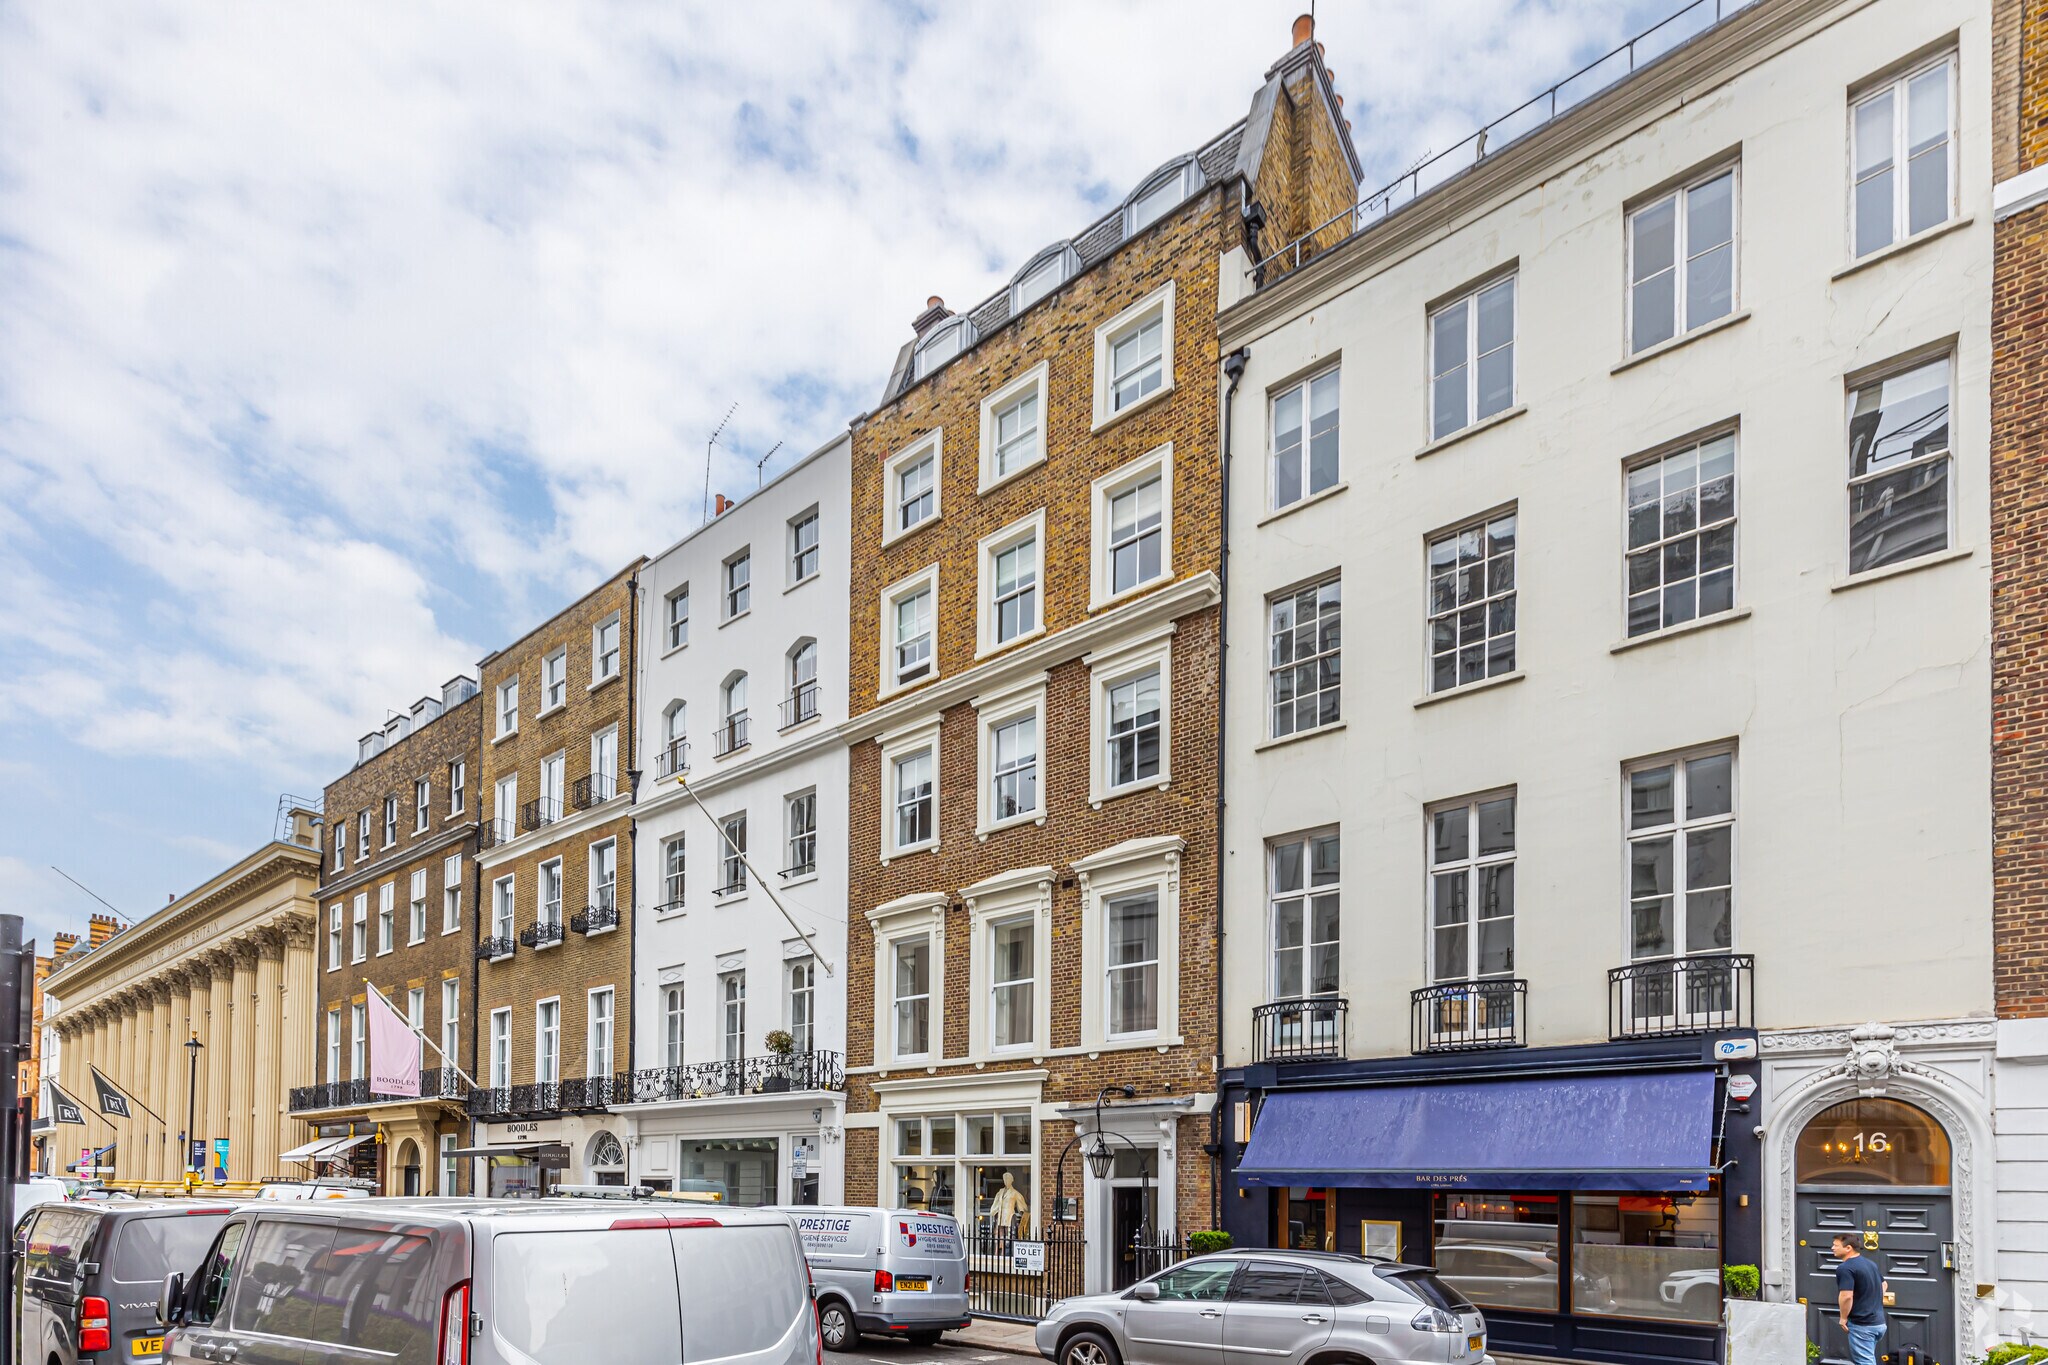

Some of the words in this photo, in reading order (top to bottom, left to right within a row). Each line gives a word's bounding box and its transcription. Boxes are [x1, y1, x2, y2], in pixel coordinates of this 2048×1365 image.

[168, 936, 187, 956] GREAT
[192, 919, 218, 941] BRITAIN
[376, 1076, 416, 1086] BOODLES
[109, 1099, 120, 1110] Ri
[63, 1108, 76, 1119] Ri
[507, 1123, 538, 1133] BOODLES
[1853, 1132, 1887, 1152] 16
[1450, 1174, 1468, 1182] PRÉS
[799, 1218, 851, 1231] PRESTIGE
[916, 1223, 955, 1235] PRESTIGE
[800, 1234, 820, 1242] YGIENE
[821, 1235, 847, 1243] SERVICES
[1016, 1247, 1027, 1255] TO
[1028, 1248, 1042, 1256] LET
[119, 1301, 158, 1310] VIVAR
[140, 1338, 164, 1352] VE
